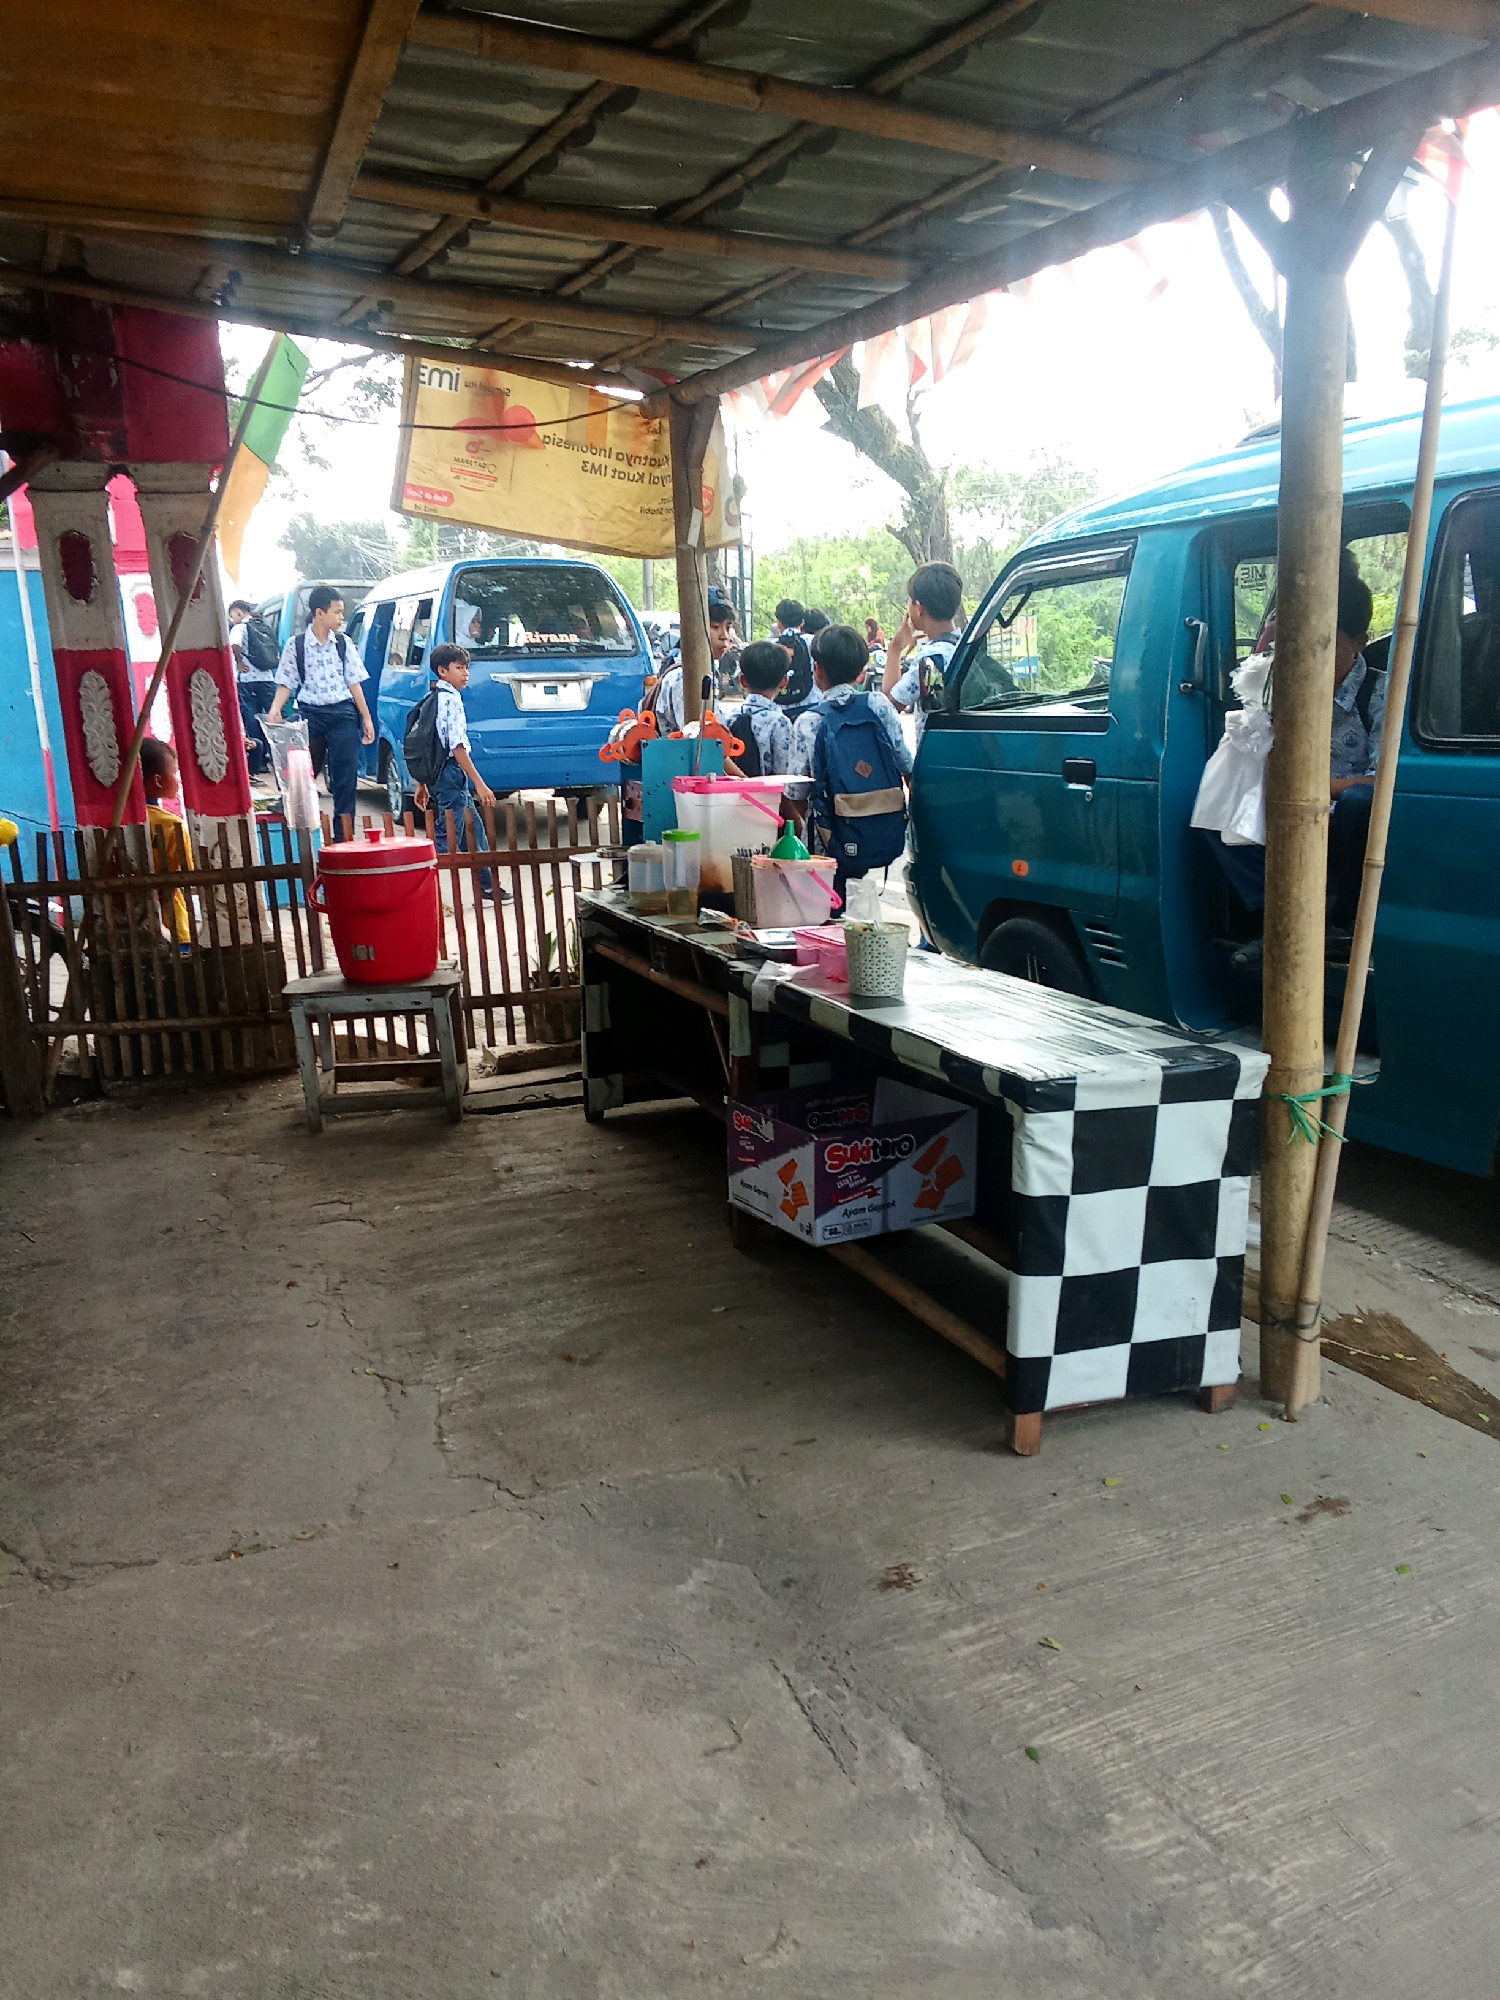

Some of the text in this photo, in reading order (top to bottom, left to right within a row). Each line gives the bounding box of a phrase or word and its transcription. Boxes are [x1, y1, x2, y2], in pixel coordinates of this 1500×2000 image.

[524, 631, 580, 644] Rivana
[824, 1133, 916, 1173] Sukitaro
[842, 1204, 867, 1219] Ayam
